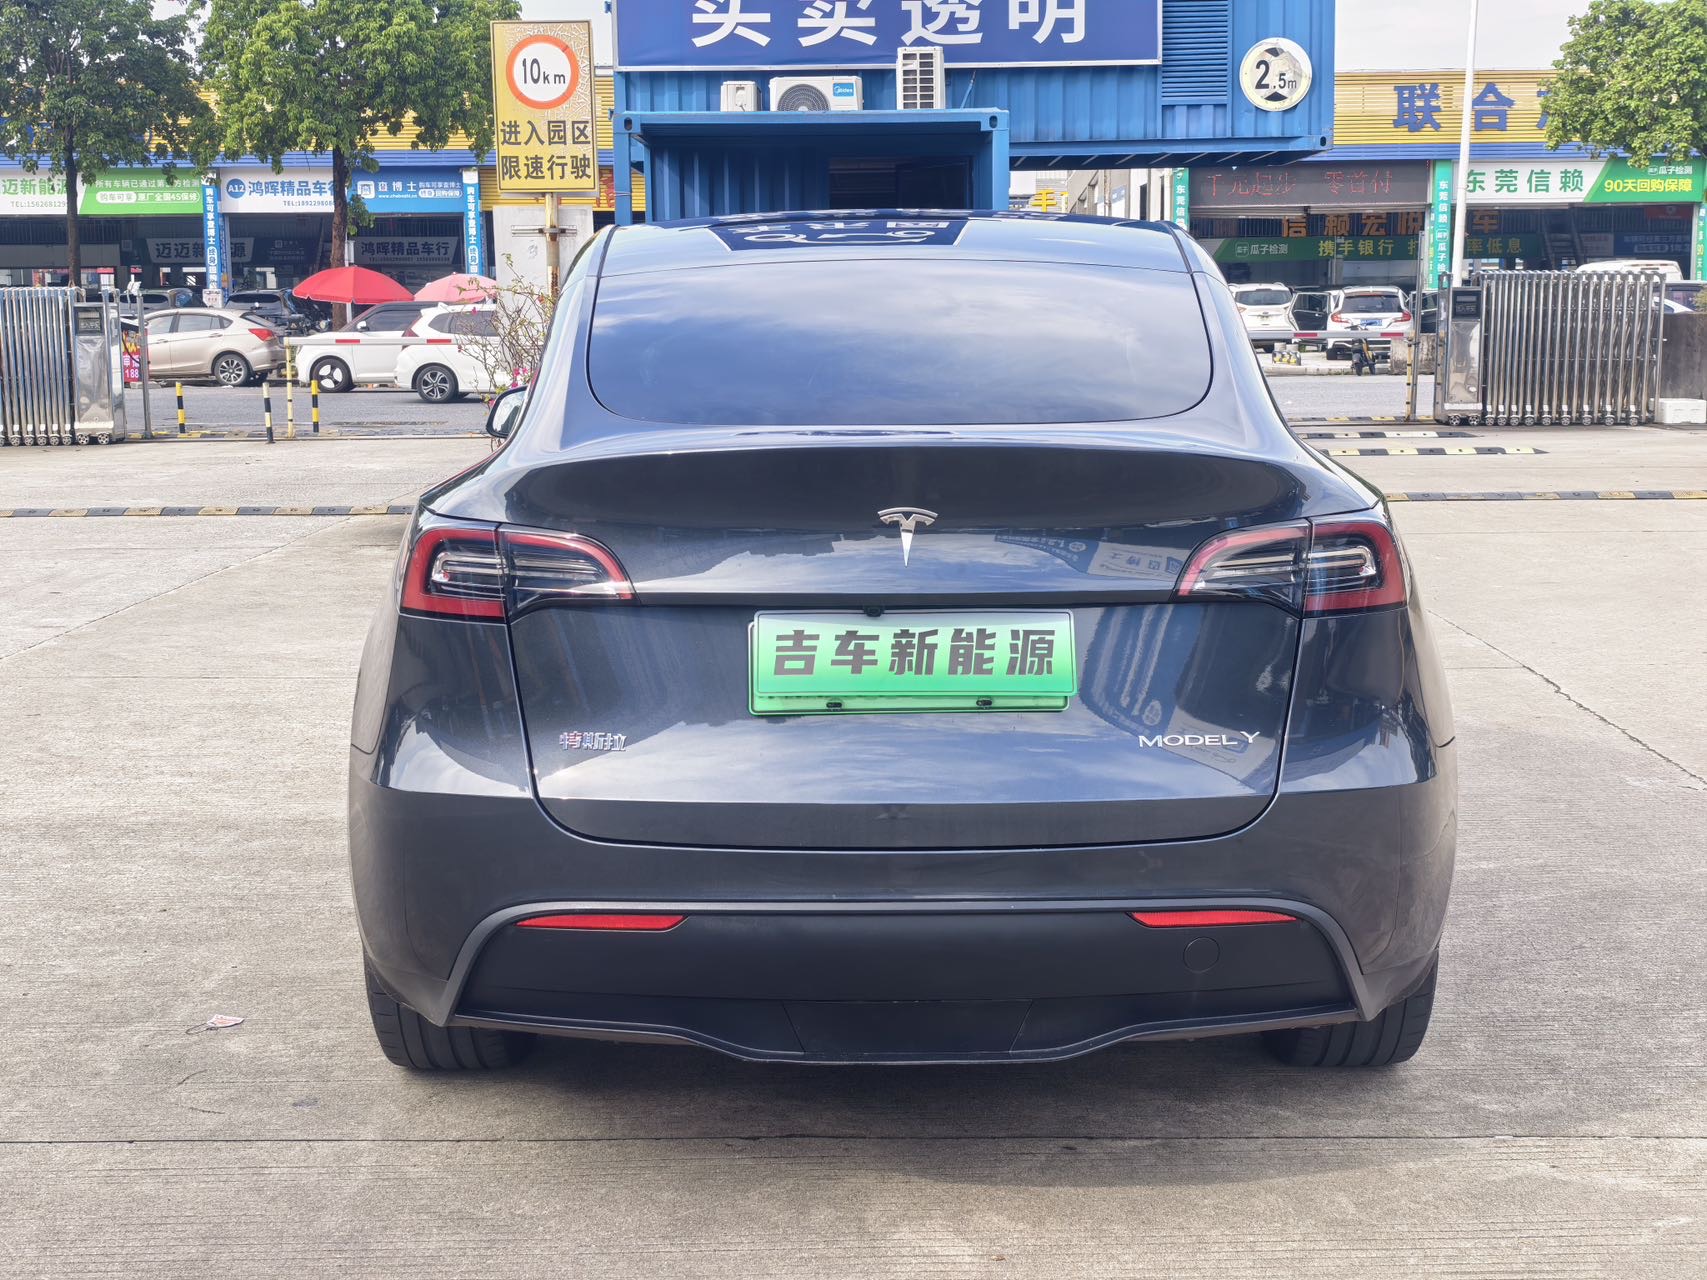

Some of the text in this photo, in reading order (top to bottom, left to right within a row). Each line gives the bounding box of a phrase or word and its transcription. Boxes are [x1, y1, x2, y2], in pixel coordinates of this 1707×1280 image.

[522, 58, 566, 85] 10km
[1255, 59, 1297, 90] 2.5m
[1393, 83, 1551, 132] 联合
[500, 120, 591, 146] 进入园区
[501, 154, 592, 180] 限速行驶
[1659, 166, 1693, 175] 瓜子检测
[228, 184, 246, 193] A12
[1465, 169, 1584, 194] 东莞信赖
[1604, 178, 1693, 193] 90天回购保障
[155, 243, 246, 258] 迈迈新源
[361, 242, 450, 256] 鸿晖精品车行
[1250, 244, 1288, 255] 瓜子检测
[1319, 240, 1394, 257] 携手银行
[773, 628, 1056, 676] 吉车新能源
[560, 731, 626, 751] 特斯拉
[1138, 731, 1260, 748] MODEL Y
